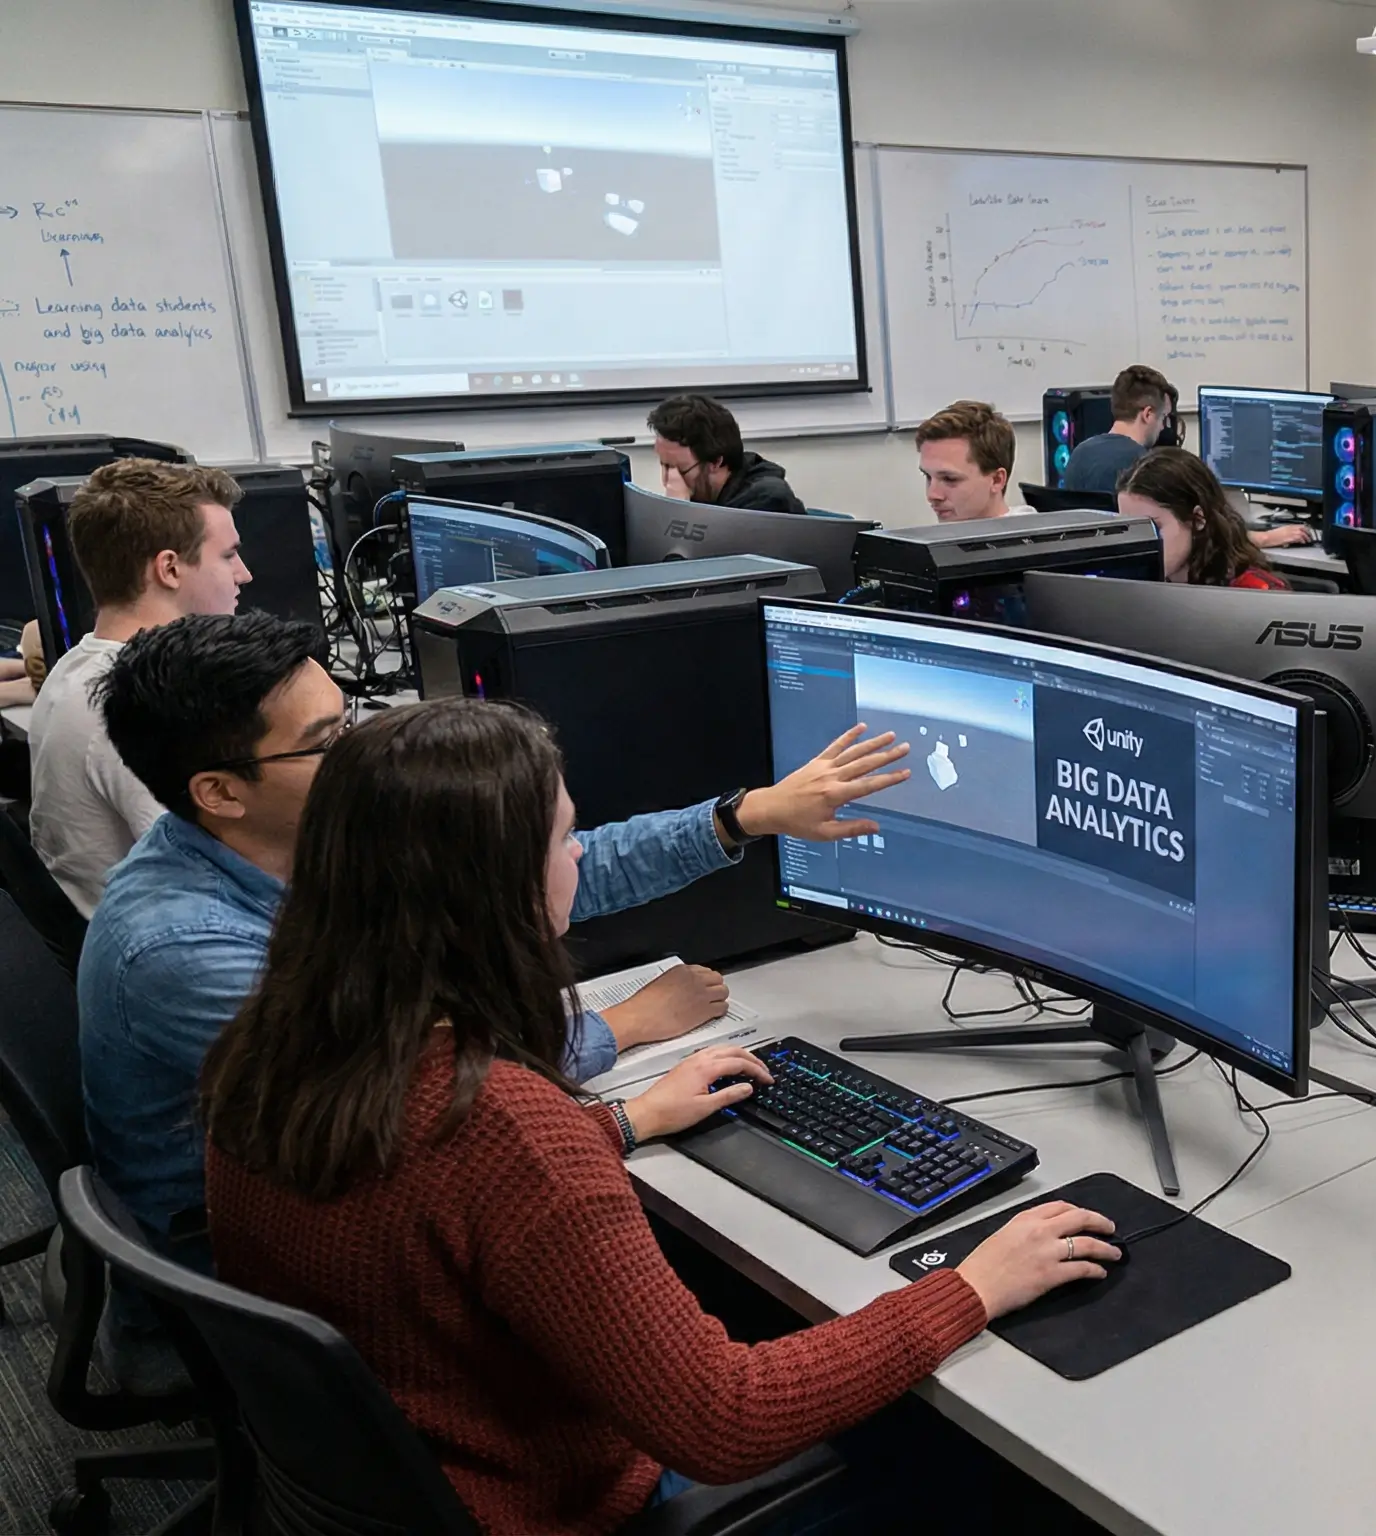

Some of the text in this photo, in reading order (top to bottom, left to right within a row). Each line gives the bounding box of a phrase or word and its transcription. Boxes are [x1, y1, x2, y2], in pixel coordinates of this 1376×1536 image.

[35, 297, 216, 319] Learning data students
[43, 322, 71, 338] and
[81, 321, 104, 345] big
[111, 321, 146, 338] data
[1255, 620, 1364, 651] ASUS
[1107, 729, 1144, 758] unity
[1057, 758, 1174, 820] BIG DATA
[1045, 794, 1186, 862] ANALYTICS
